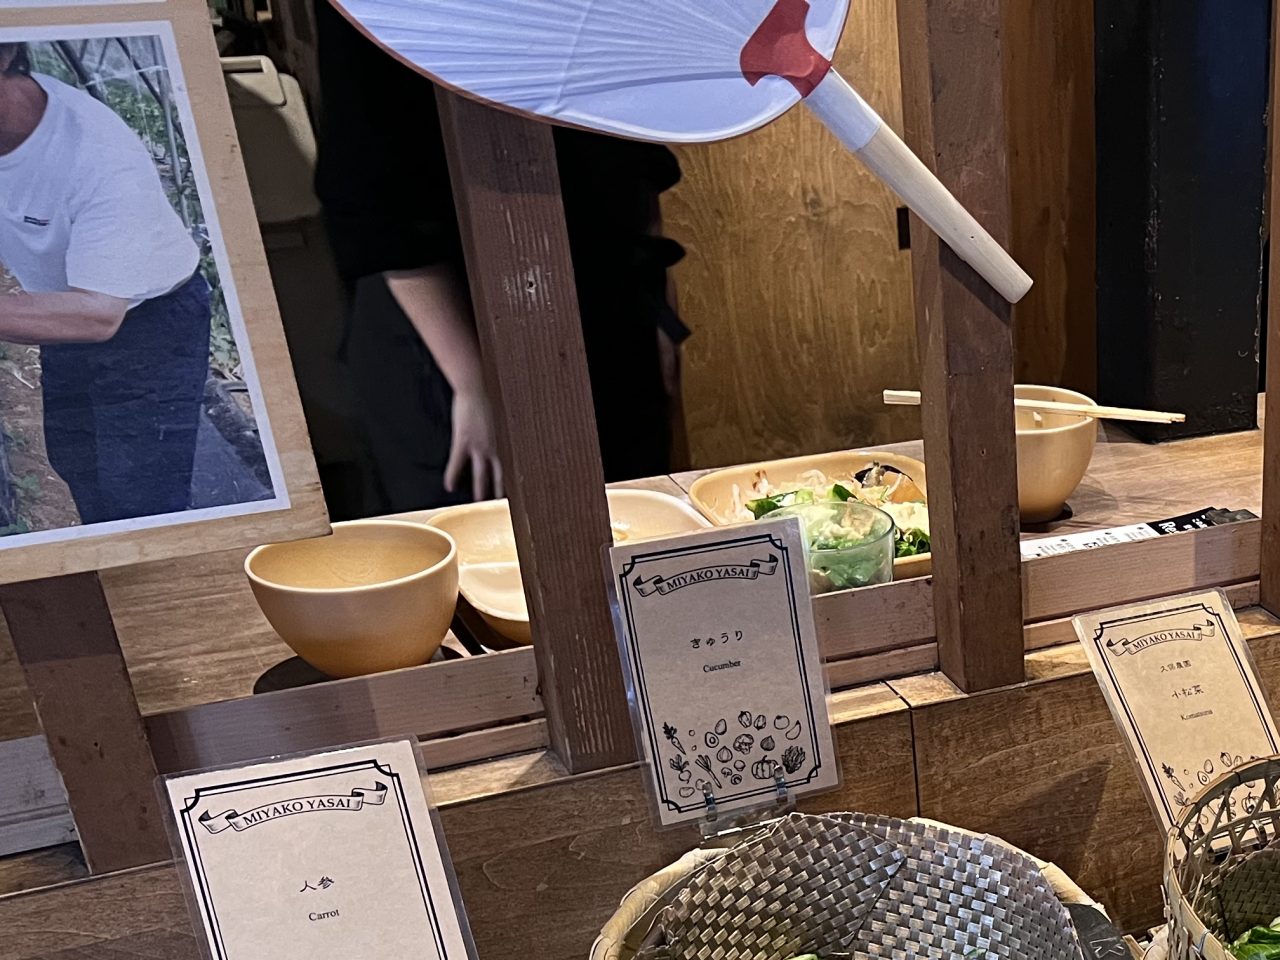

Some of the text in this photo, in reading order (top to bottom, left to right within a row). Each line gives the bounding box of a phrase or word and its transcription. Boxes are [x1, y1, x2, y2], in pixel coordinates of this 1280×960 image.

[666, 567, 749, 590] MIYAKO YASAI
[690, 630, 743, 649] きゅうり
[1133, 631, 1196, 651] MIYAKO YASAI
[703, 660, 741, 673] Cucumber
[1171, 684, 1205, 699] 小松菜
[243, 798, 351, 826] MIYAKO YASAI
[300, 875, 335, 892] 人参
[308, 908, 340, 922] Carrot
